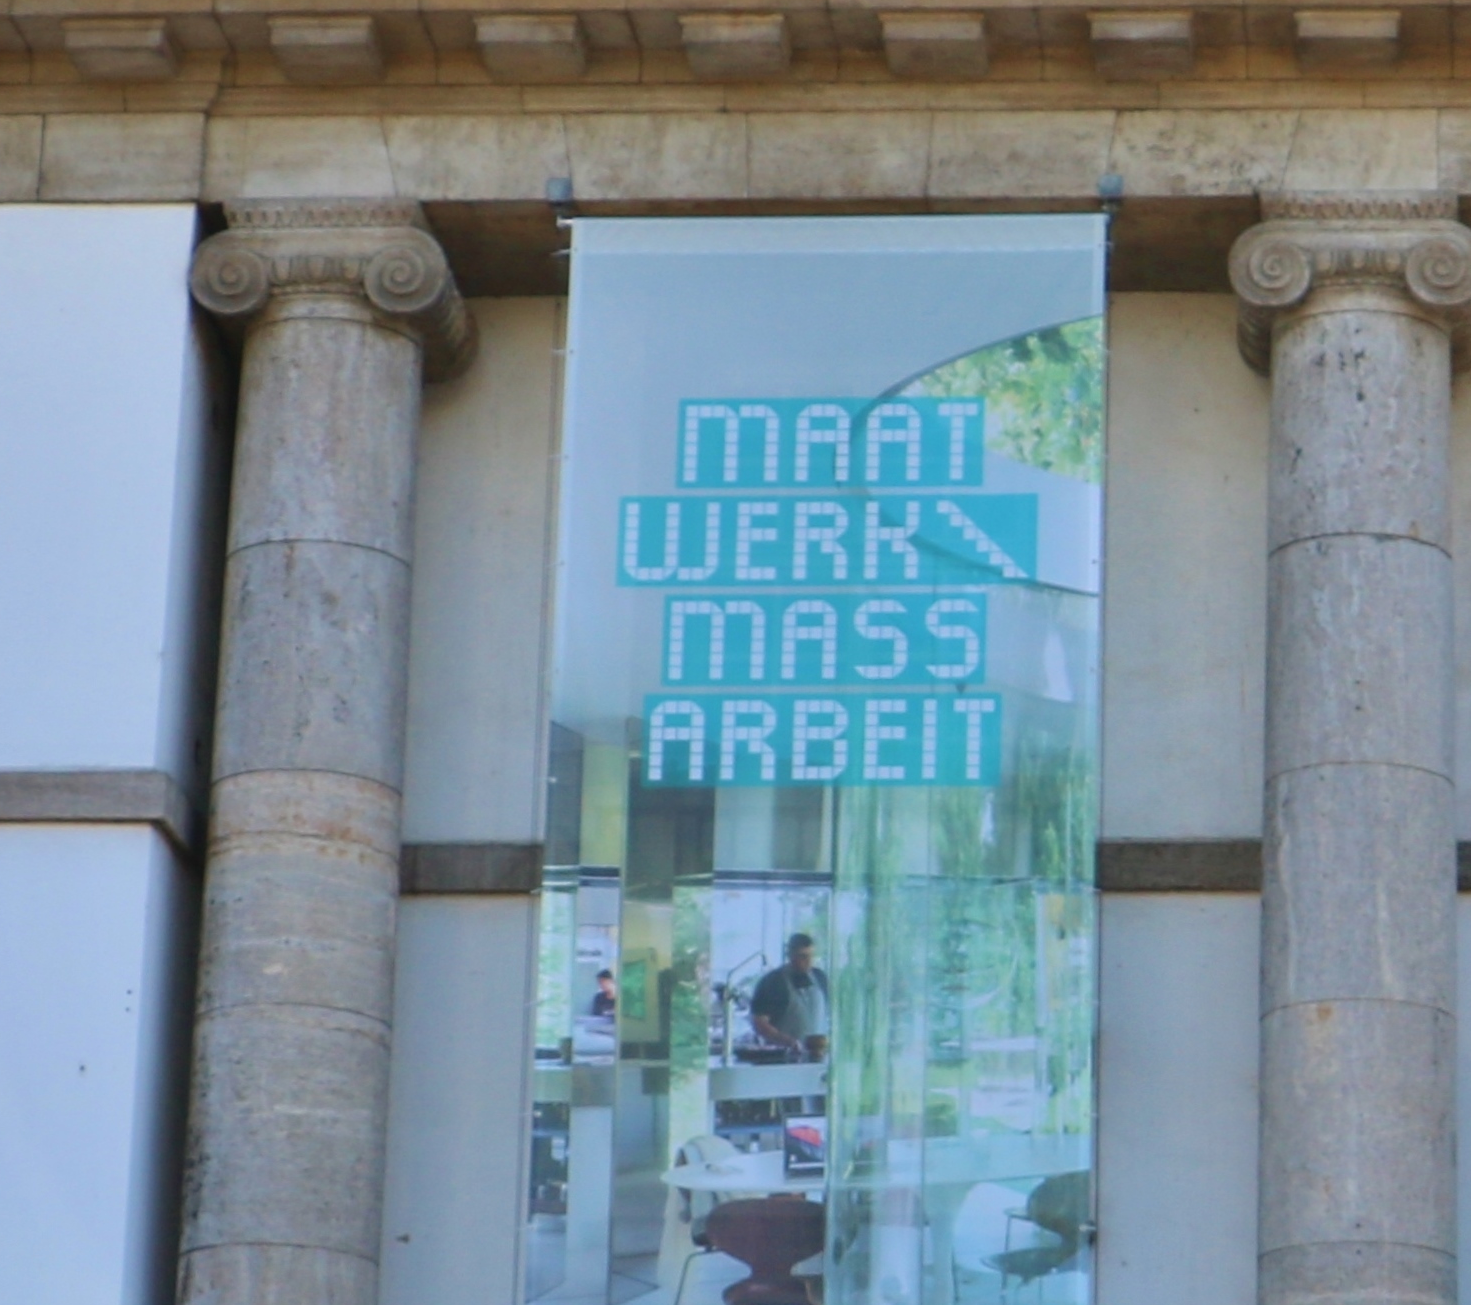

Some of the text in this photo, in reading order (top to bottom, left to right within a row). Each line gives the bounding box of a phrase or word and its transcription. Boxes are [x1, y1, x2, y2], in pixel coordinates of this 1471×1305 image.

[682, 402, 979, 483] MAAT
[667, 599, 980, 681] MASS
[646, 698, 996, 781] ARBEIT
